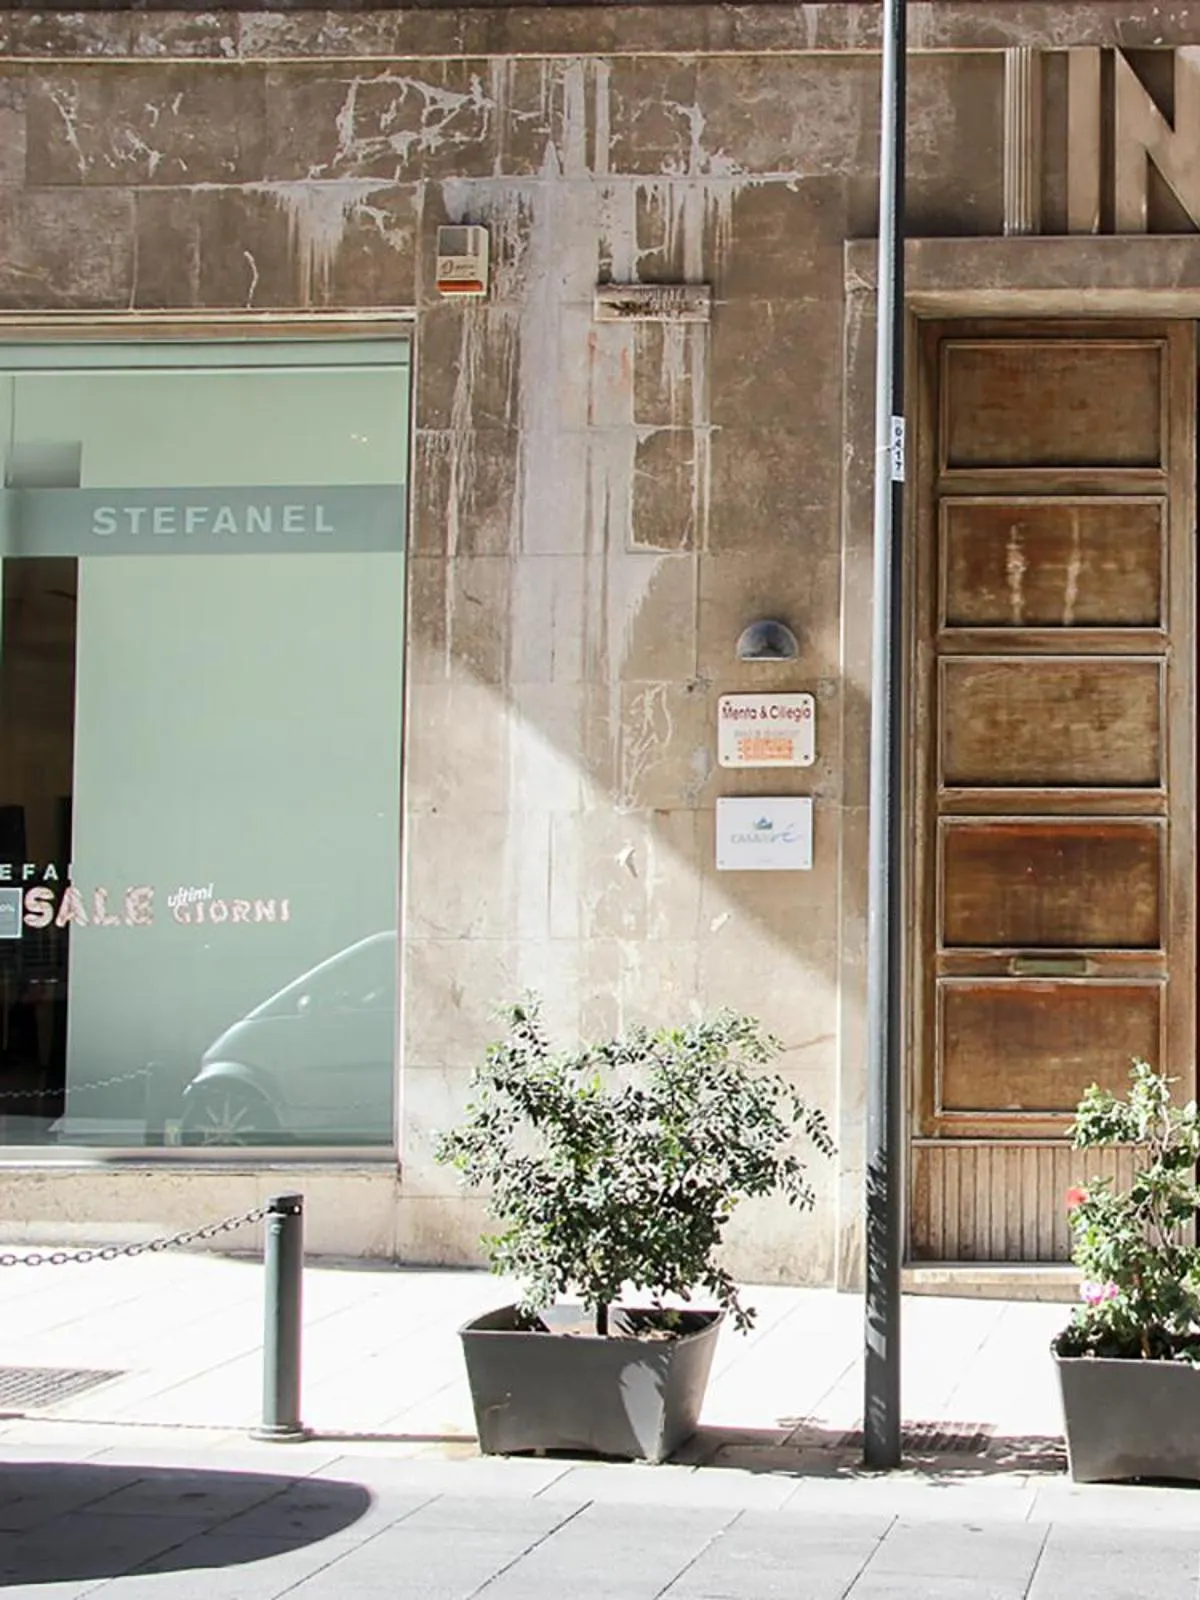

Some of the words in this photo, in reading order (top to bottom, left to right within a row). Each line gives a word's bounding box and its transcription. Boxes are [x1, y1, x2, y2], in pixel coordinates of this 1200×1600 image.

[895, 427, 903, 470] 0417
[92, 505, 334, 535] STEFANEL
[23, 886, 155, 928] SALE
[167, 883, 214, 907] ultimi
[173, 899, 290, 924] GIORNI
